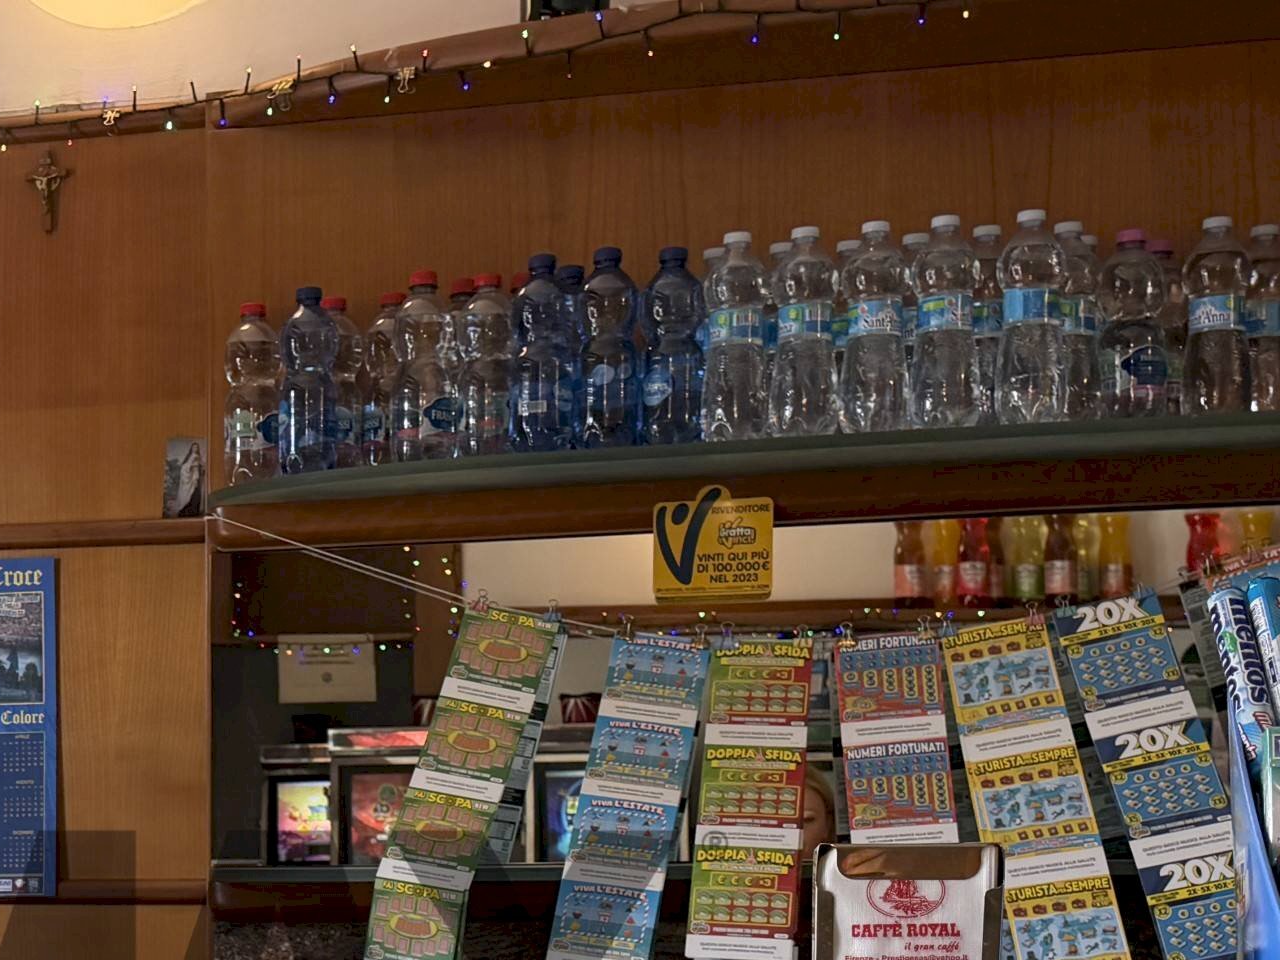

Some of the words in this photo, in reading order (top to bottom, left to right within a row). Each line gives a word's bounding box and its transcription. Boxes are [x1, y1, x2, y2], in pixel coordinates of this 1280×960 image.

[711, 503, 770, 515] RIVENDITORE
[696, 553, 724, 562] VINTI
[728, 552, 748, 561] QUI
[751, 548, 769, 561] PIÙ
[696, 564, 709, 573] DI
[710, 574, 729, 583] NEL
[732, 573, 759, 583] 2023
[1073, 597, 1145, 633] 20X
[774, 644, 809, 659] SFIDA
[0, 710, 45, 726] Colore
[1114, 720, 1192, 760] 20X
[707, 748, 754, 761] DOPPIA
[765, 748, 802, 764] SFIDA
[846, 744, 886, 761] NUMERI
[887, 741, 946, 756] FORTUNATI
[1033, 747, 1075, 764] SEMPRE
[696, 849, 746, 862] DOPPIA
[757, 850, 793, 867] SFIDA
[1160, 851, 1235, 892] 20X
[1064, 877, 1110, 893] SEMPRE
[851, 920, 903, 938] CAFFÈ
[907, 922, 961, 938] ROYAL
[913, 943, 935, 953] gran
